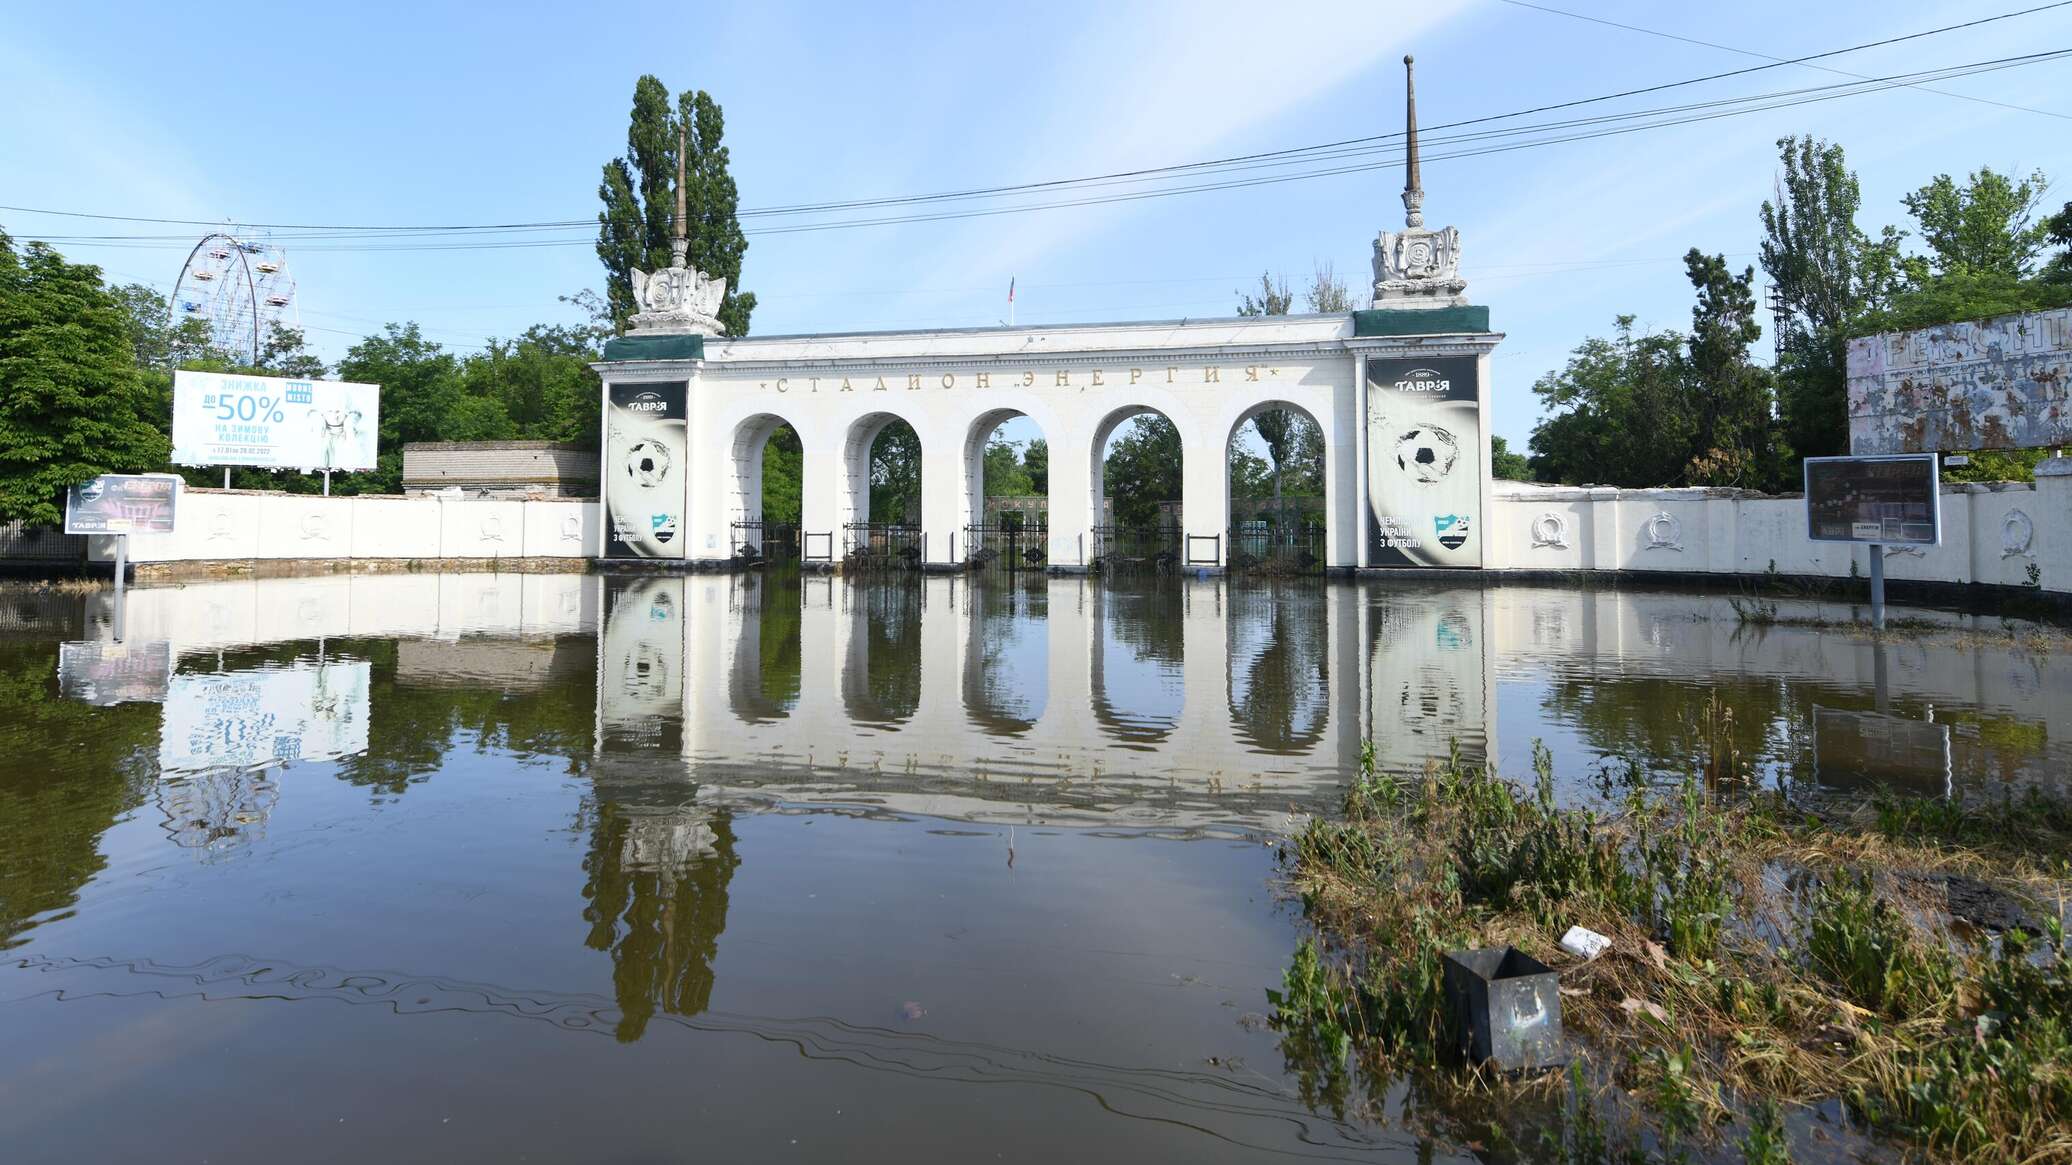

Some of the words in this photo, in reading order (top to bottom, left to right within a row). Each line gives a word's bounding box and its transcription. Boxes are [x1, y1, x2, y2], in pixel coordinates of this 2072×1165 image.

[221, 379, 266, 393] ЗНИЖКА
[776, 371, 991, 393] СТАДИОН
[1394, 380, 1450, 391] ТАВРІЯ
[628, 401, 667, 411] ТАВРІЯ
[215, 424, 227, 432] НА
[231, 425, 270, 434] ЗИМОВУ
[218, 433, 269, 443] КОЛЕКЦІЮ
[1380, 538, 1386, 548] З
[1387, 538, 1422, 548] ФУТБОЛУ
